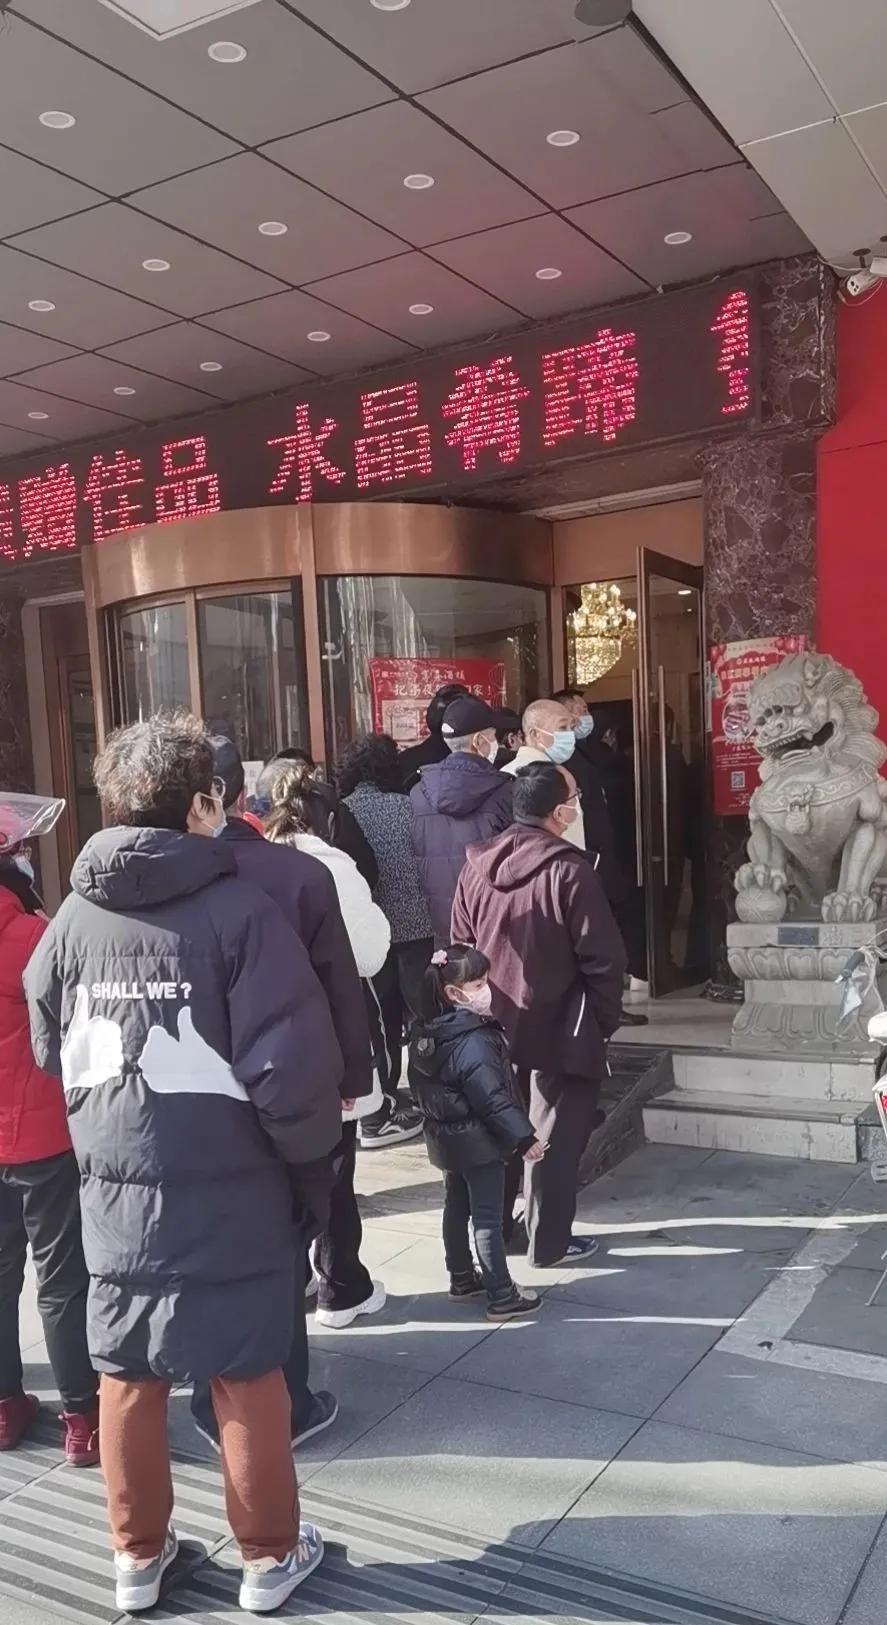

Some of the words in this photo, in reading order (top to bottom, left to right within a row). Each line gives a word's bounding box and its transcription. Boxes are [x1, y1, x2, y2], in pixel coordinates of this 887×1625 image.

[0, 436, 220, 560] 赠佳品
[266, 328, 639, 503] 水晶肴蹄
[91, 981, 144, 1000] SHALL
